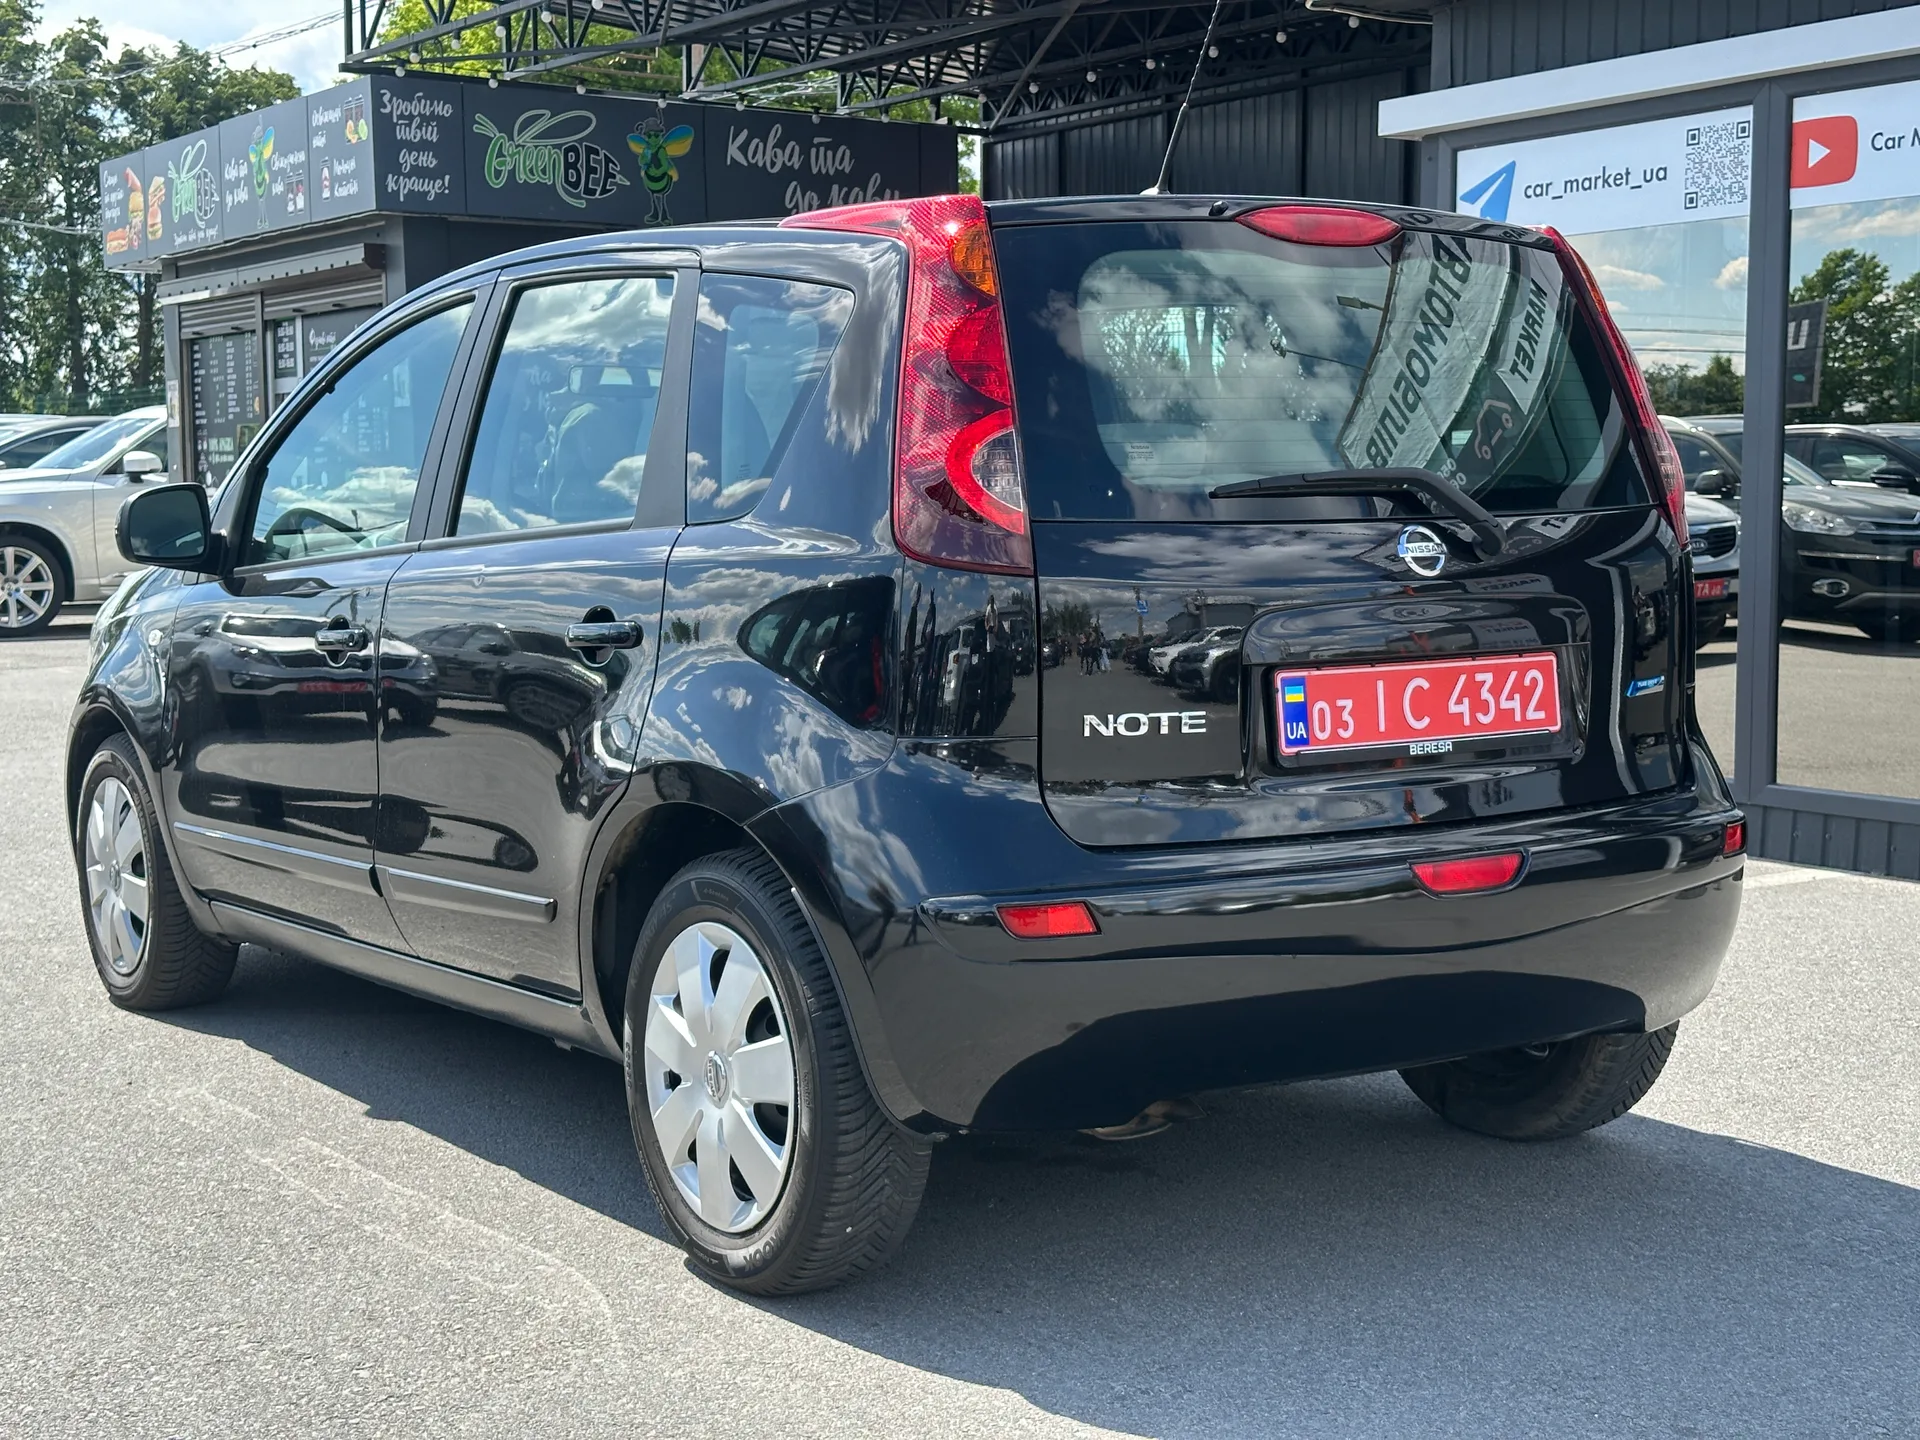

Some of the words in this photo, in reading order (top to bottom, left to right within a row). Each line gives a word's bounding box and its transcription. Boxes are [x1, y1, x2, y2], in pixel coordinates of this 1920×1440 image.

[380, 89, 453, 122] Зробимо
[396, 120, 439, 142] твій
[1871, 132, 1905, 151] Car
[399, 148, 438, 173] день
[726, 124, 805, 174] Кава
[810, 137, 854, 175] та
[385, 174, 450, 201] краще!
[1524, 166, 1668, 200] car_market_ua
[785, 180, 821, 214] до
[1405, 543, 1446, 554] NISSAN
[1312, 699, 1355, 741] 03
[1448, 668, 1546, 727] 4342
[1083, 711, 1207, 737] NOTE
[1286, 722, 1307, 739] UA
[1409, 741, 1453, 755] BERESA
